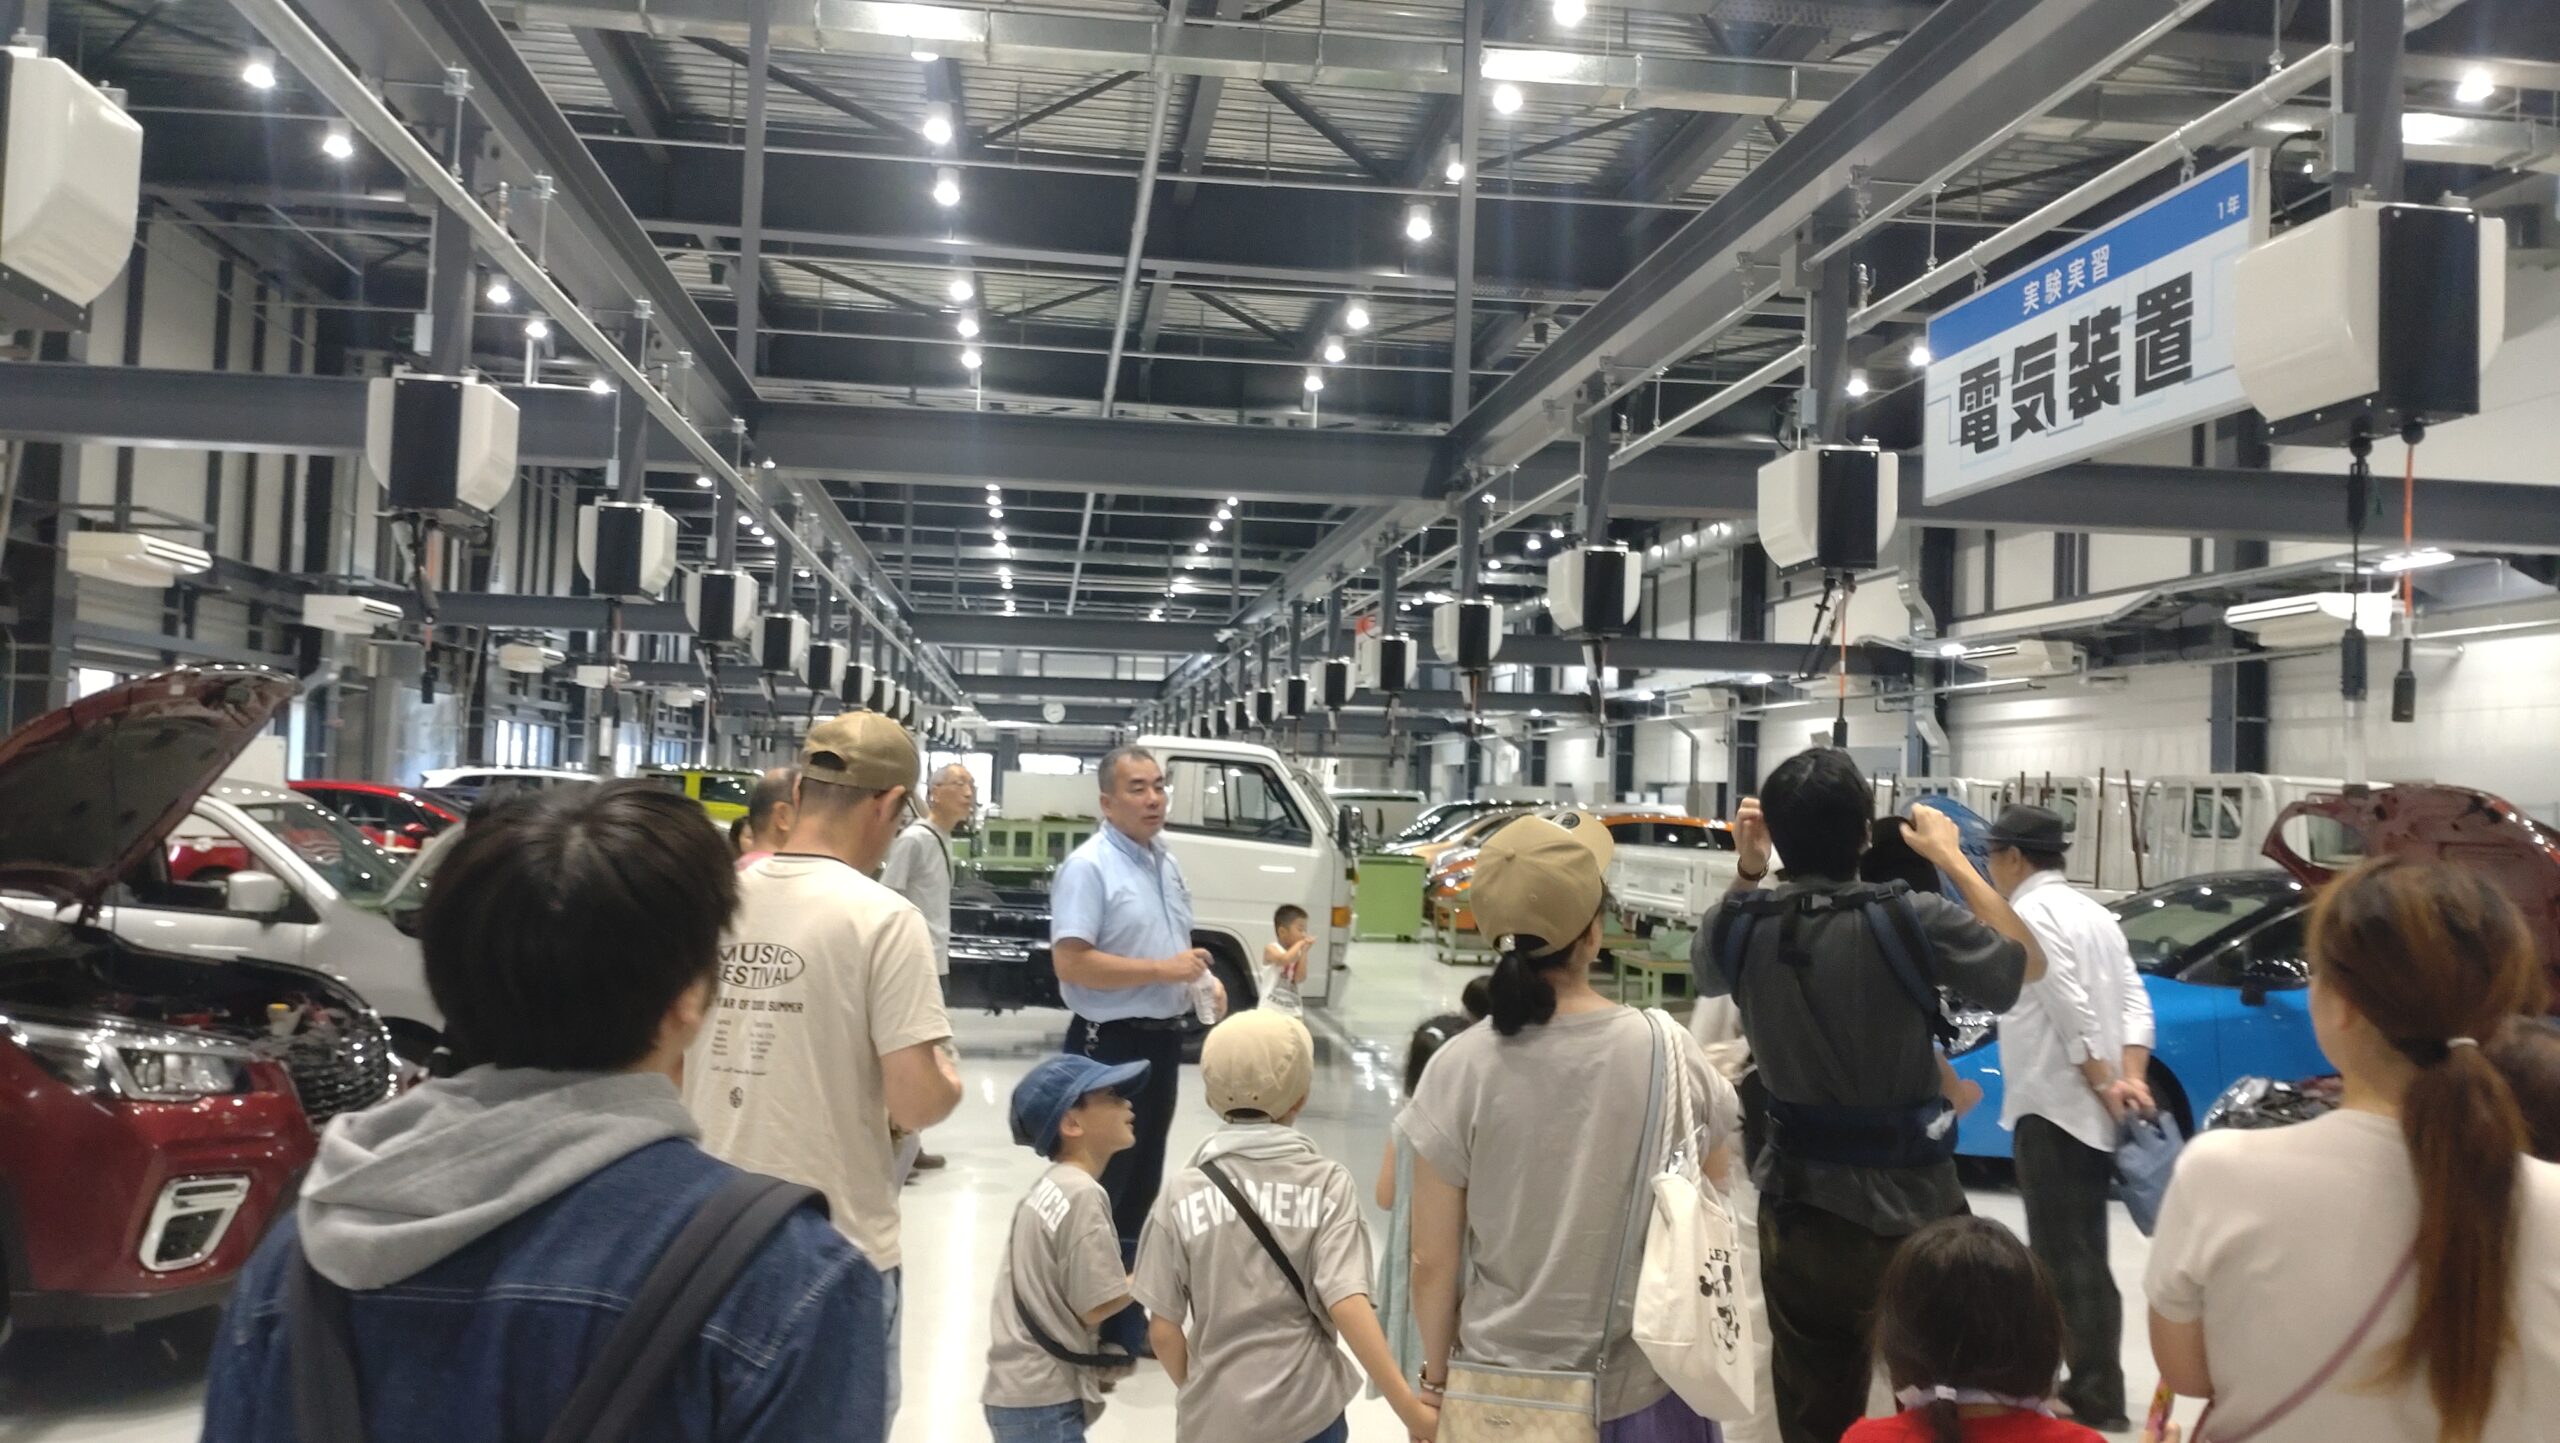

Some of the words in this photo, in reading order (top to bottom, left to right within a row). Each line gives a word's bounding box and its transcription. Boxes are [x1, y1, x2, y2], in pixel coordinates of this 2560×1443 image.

[2217, 194, 2241, 220] 1年
[2022, 244, 2110, 316] 実験実習
[1958, 271, 2194, 454] 電気装置
[719, 944, 794, 965] MUSIC
